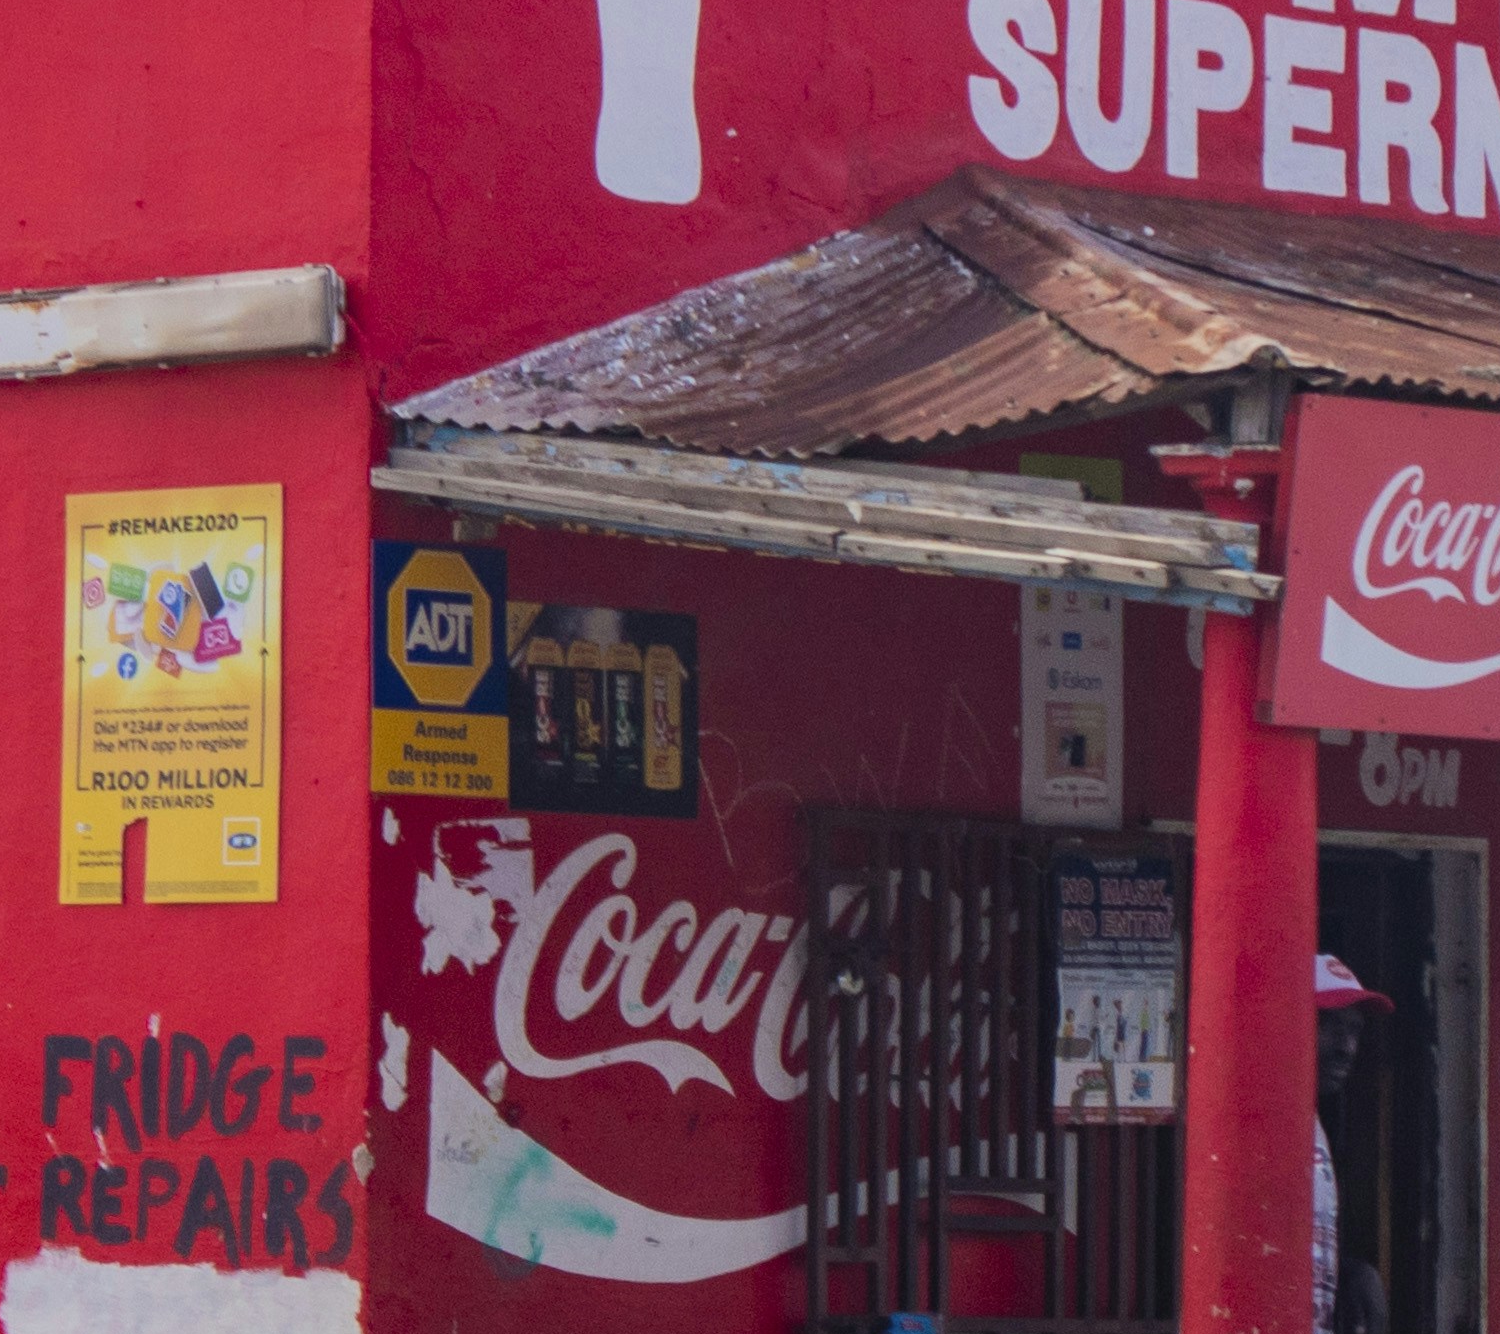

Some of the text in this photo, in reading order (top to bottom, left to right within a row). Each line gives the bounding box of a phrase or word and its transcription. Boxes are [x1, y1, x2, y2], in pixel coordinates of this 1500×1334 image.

[108, 513, 239, 537] #REMAKE2020
[405, 601, 474, 654] ADT
[414, 720, 468, 740] Armed
[403, 744, 478, 767] Response
[92, 768, 248, 792] R100 MILLION
[421, 770, 439, 788] 12
[444, 772, 461, 789] 12
[122, 793, 215, 810] IN REWARDS
[1061, 876, 1095, 905] NO
[1101, 909, 1175, 939] ENTRY
[40, 1033, 329, 1153] FRIDGE
[40, 1154, 354, 1267] REPAIRS
